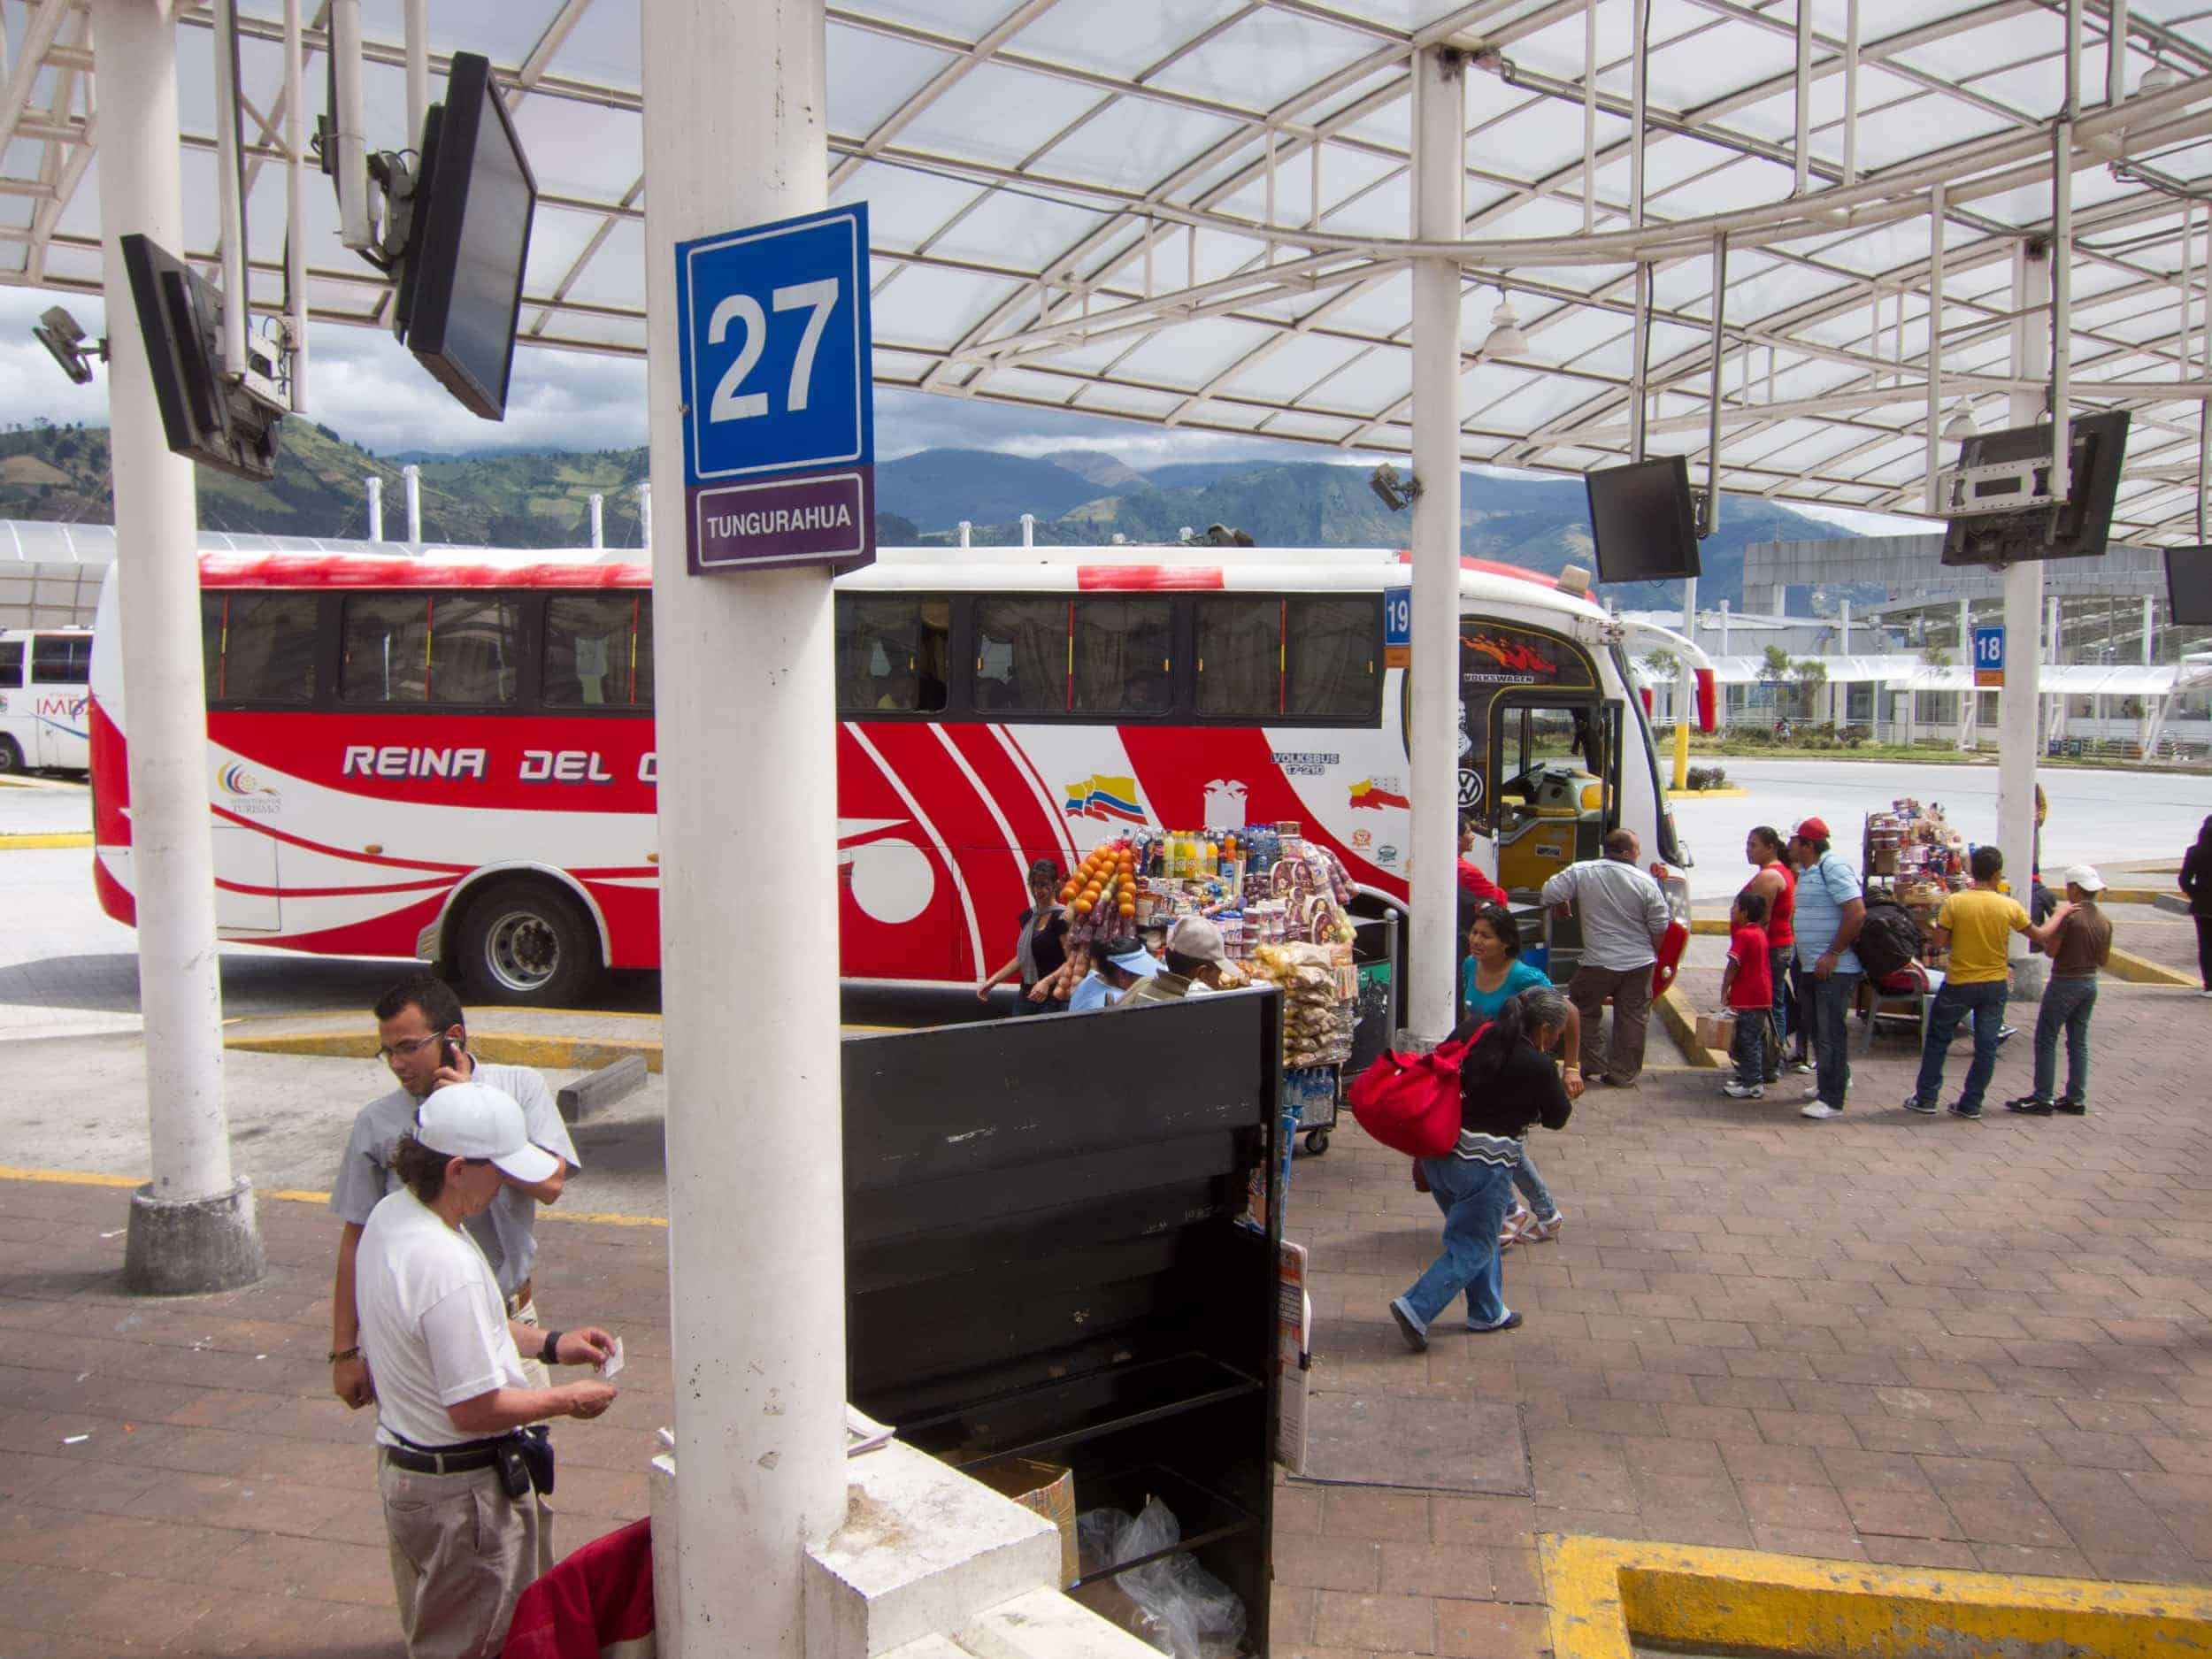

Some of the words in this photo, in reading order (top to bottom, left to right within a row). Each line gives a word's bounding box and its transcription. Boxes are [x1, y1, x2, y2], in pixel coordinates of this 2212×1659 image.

[708, 277, 839, 424] 27
[707, 503, 851, 539] TUNGURAHUA
[1387, 600, 1409, 633] 19
[1978, 636, 2001, 661] 18
[342, 745, 488, 780] REINA
[518, 749, 614, 783] DEL
[1271, 753, 1340, 764] VOLKSBUS
